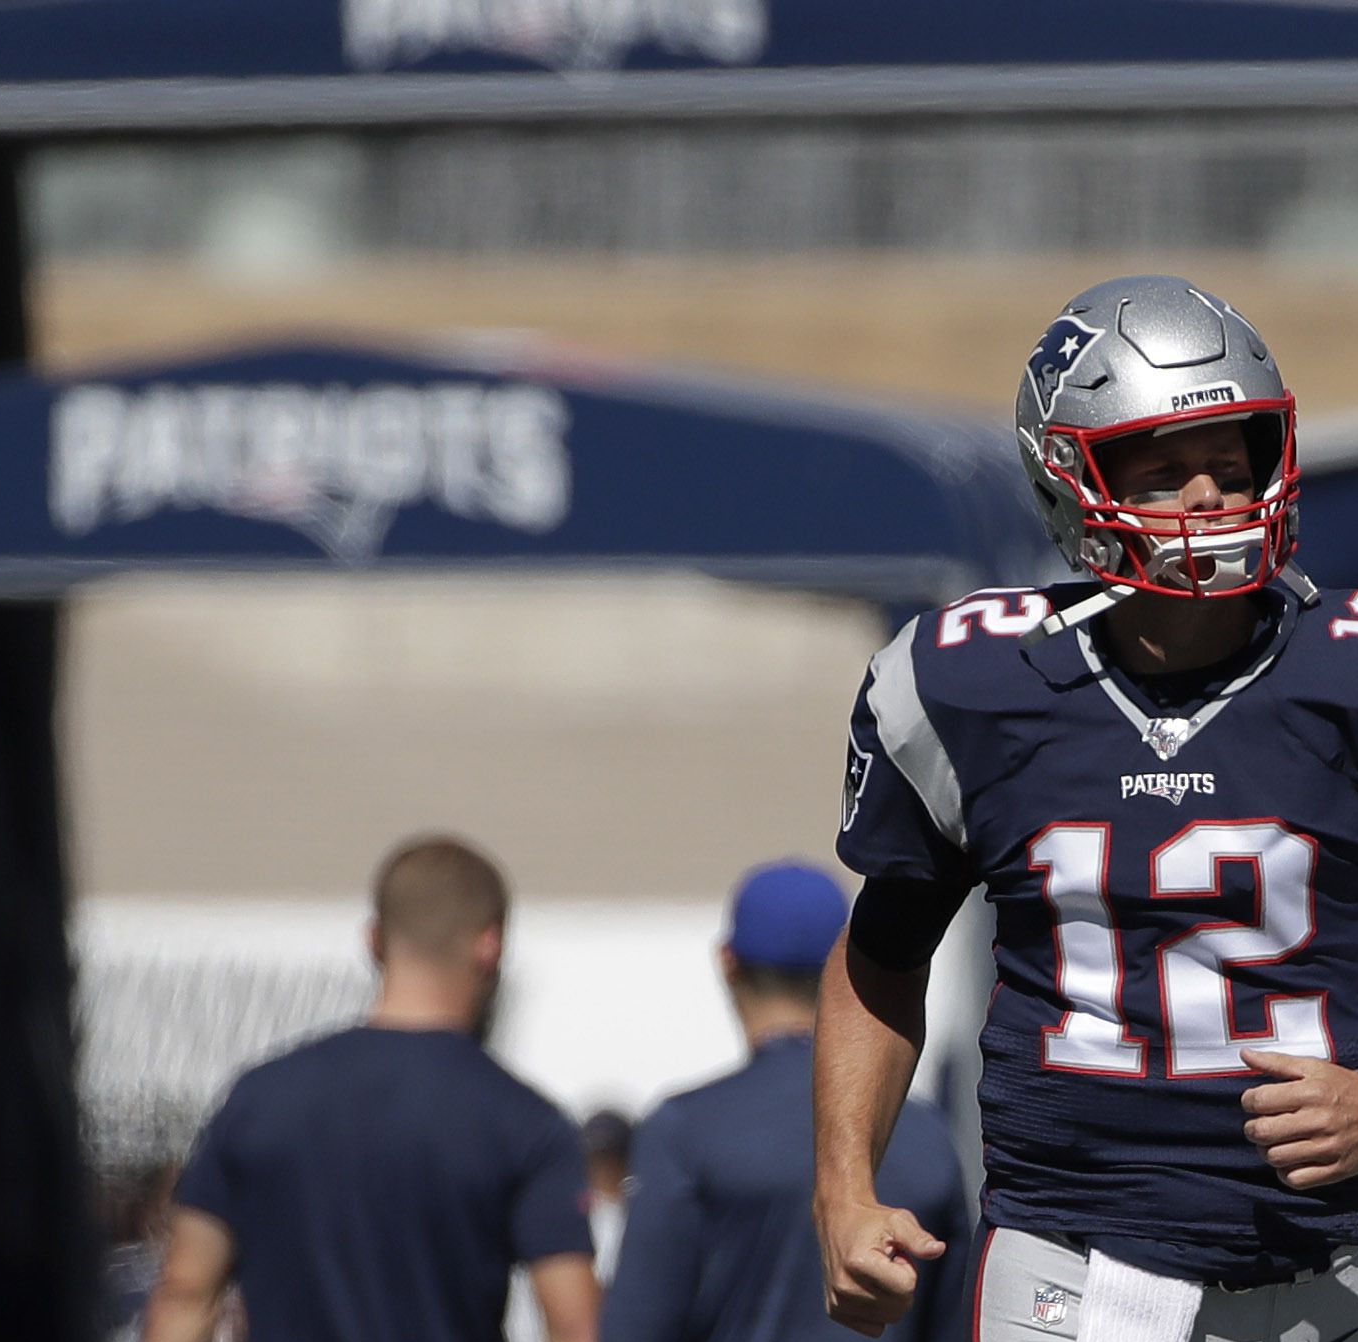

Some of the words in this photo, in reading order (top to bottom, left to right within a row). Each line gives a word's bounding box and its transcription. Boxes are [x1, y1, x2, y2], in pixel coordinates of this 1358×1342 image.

[1171, 386, 1235, 412] PATRIOTS
[49, 382, 571, 536] PATRIOTS
[1121, 773, 1216, 800] PATRIOTS
[1027, 816, 1337, 1079] 12
